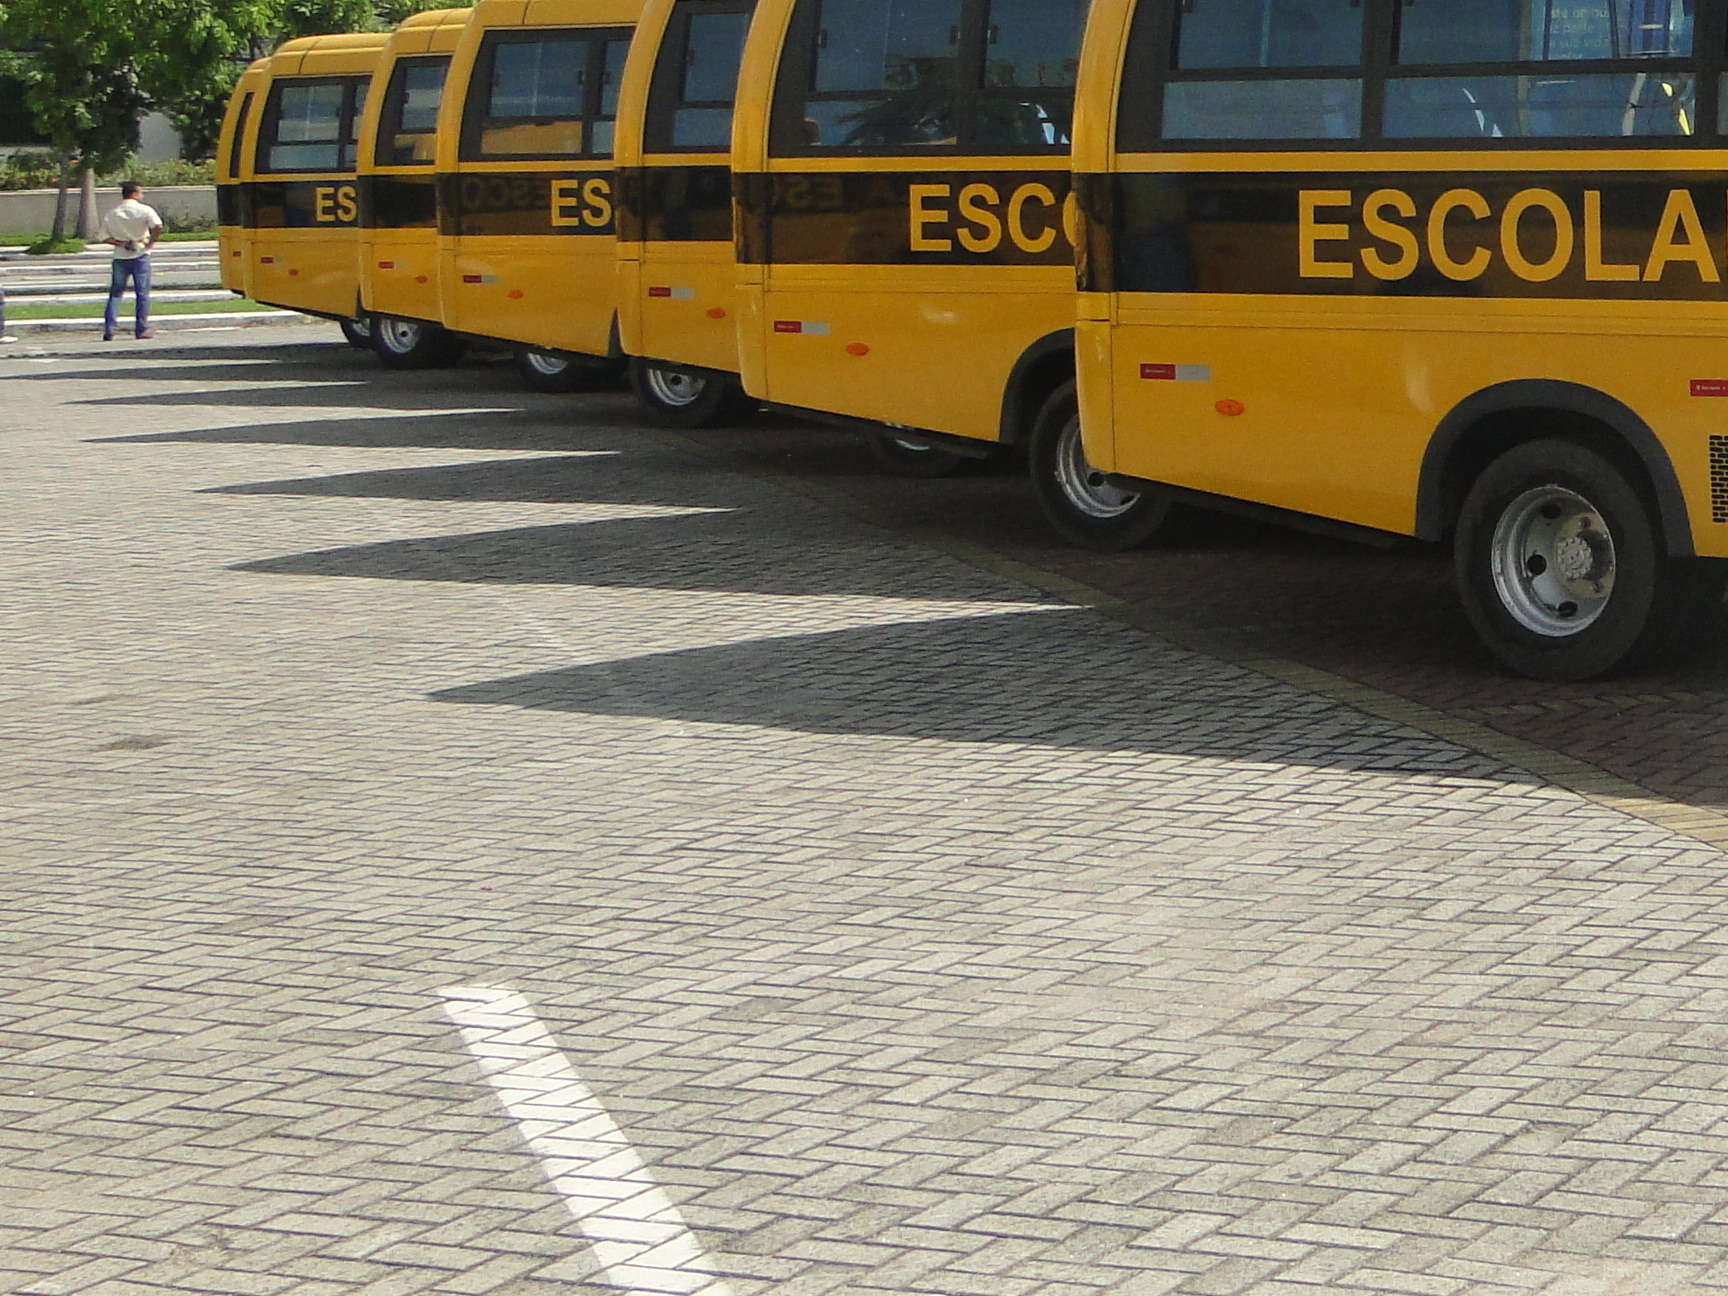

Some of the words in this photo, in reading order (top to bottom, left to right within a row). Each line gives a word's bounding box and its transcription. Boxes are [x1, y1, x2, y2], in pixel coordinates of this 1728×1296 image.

[314, 185, 357, 223] ES
[551, 178, 613, 228] ES
[909, 182, 1076, 253] ESC
